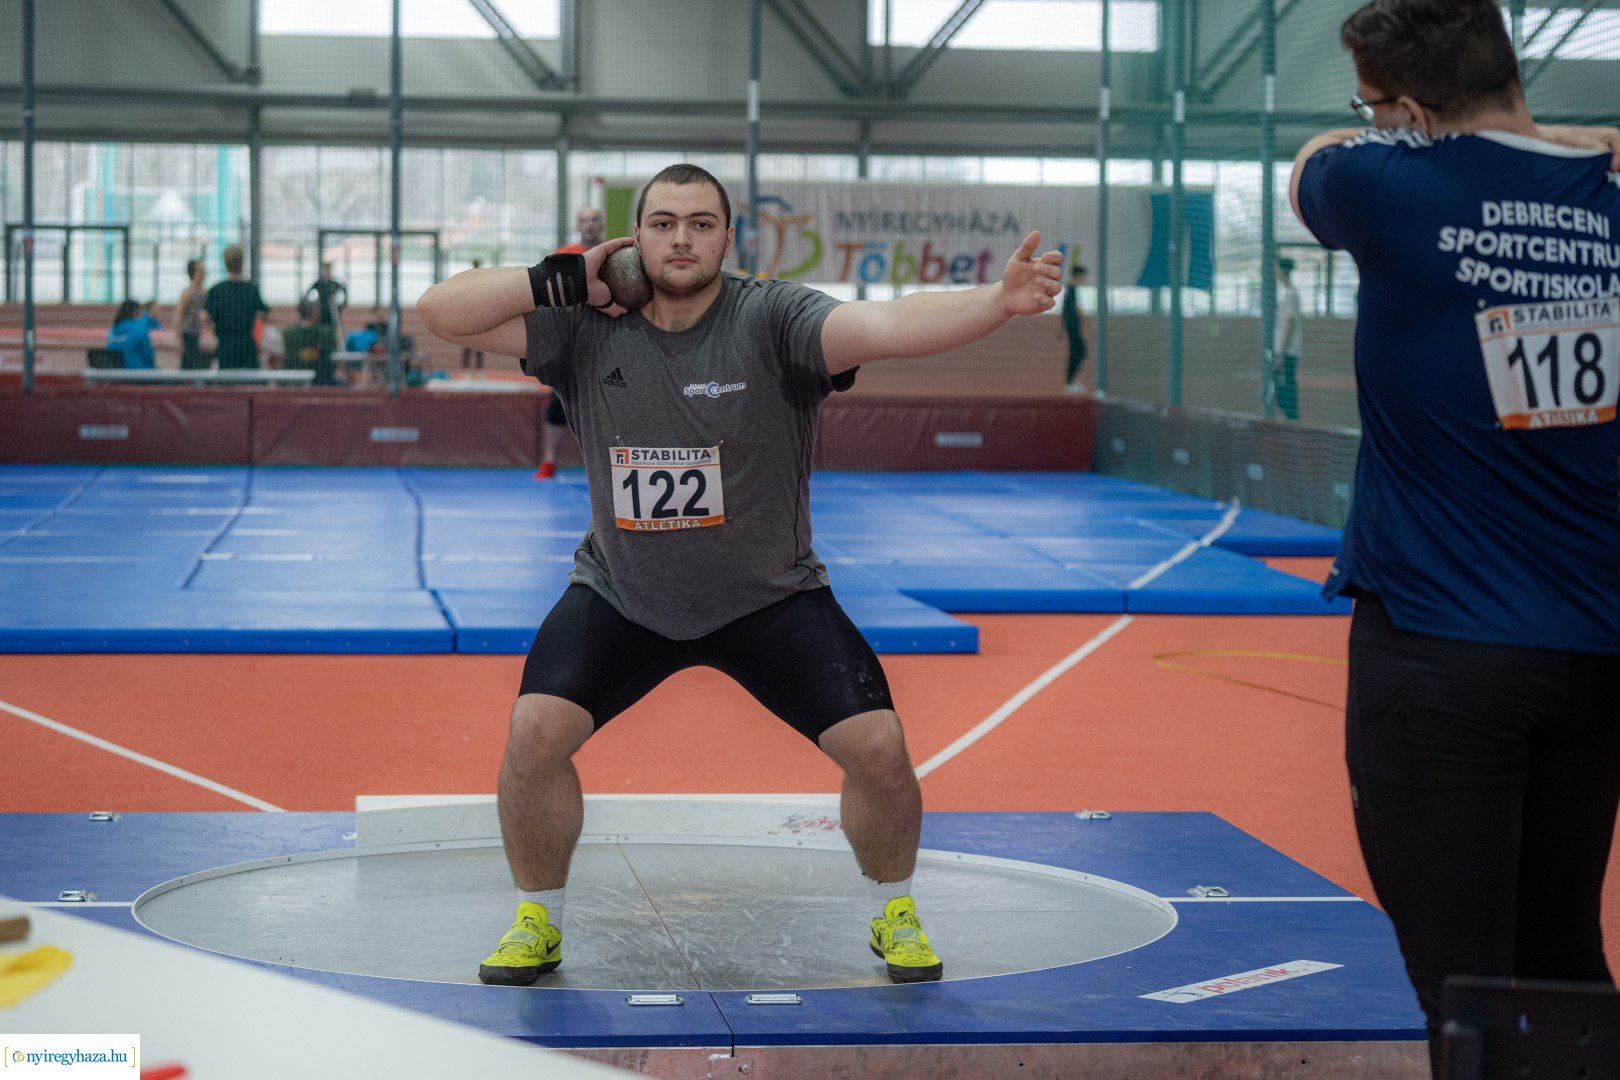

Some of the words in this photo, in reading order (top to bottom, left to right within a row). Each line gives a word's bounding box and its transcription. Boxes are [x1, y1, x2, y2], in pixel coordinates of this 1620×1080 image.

[1481, 200, 1609, 240] DEBRECENI
[833, 240, 994, 285] Többet
[1513, 302, 1611, 323] STABILITA
[601, 378, 627, 389] adidas
[1508, 332, 1606, 409] 118
[631, 449, 712, 461] STABILITA
[622, 469, 709, 519] 122
[634, 519, 701, 530] ATLETIKA
